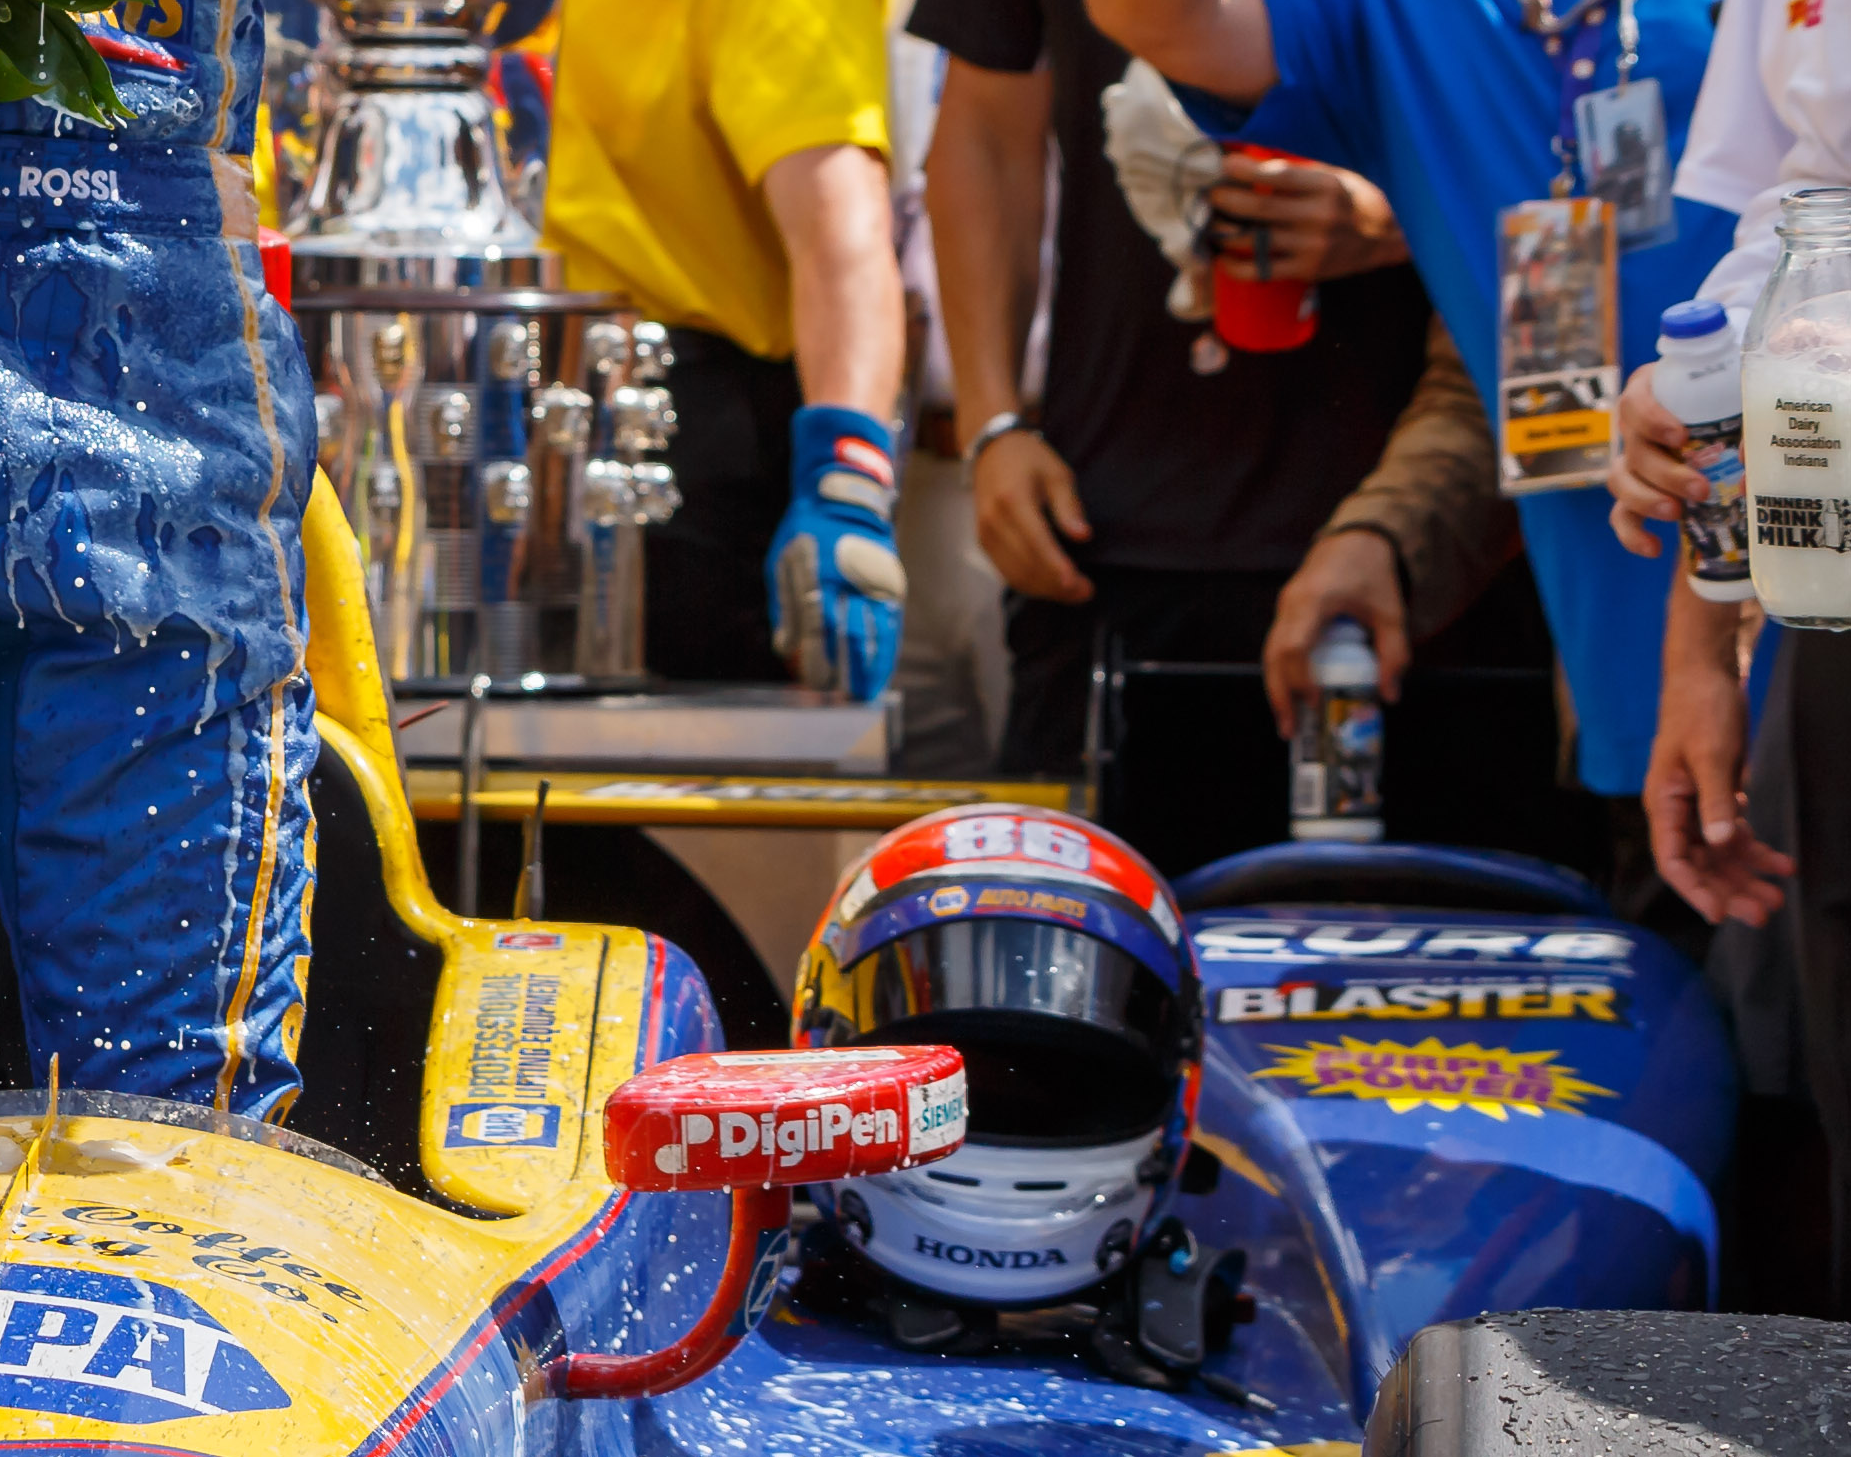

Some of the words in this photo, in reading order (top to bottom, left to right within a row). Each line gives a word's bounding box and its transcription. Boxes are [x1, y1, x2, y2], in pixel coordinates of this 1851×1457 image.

[19, 165, 119, 202] ROSSI
[1775, 397, 1833, 413] American
[1770, 434, 1842, 450] Association
[1788, 416, 1820, 434] Dairy
[1784, 453, 1829, 468] Indiana
[1754, 495, 1823, 510] WINNERS
[1756, 507, 1824, 528] DRINK
[1757, 525, 1820, 549] MILK
[943, 817, 1091, 871] 86
[976, 888, 1030, 907] AUTO
[1030, 891, 1087, 920] PARTS
[1194, 921, 1637, 961] CURB
[520, 972, 563, 1045] EQUIPMENT
[467, 972, 523, 1099] PROFESSIONAL
[514, 1047, 552, 1100] LIFTING
[1316, 1067, 1554, 1103] POWER
[484, 1111, 527, 1139] NAPA
[718, 1103, 899, 1168] DigiPen
[62, 1205, 370, 1312] Coffee
[913, 1233, 1069, 1270] HONDA
